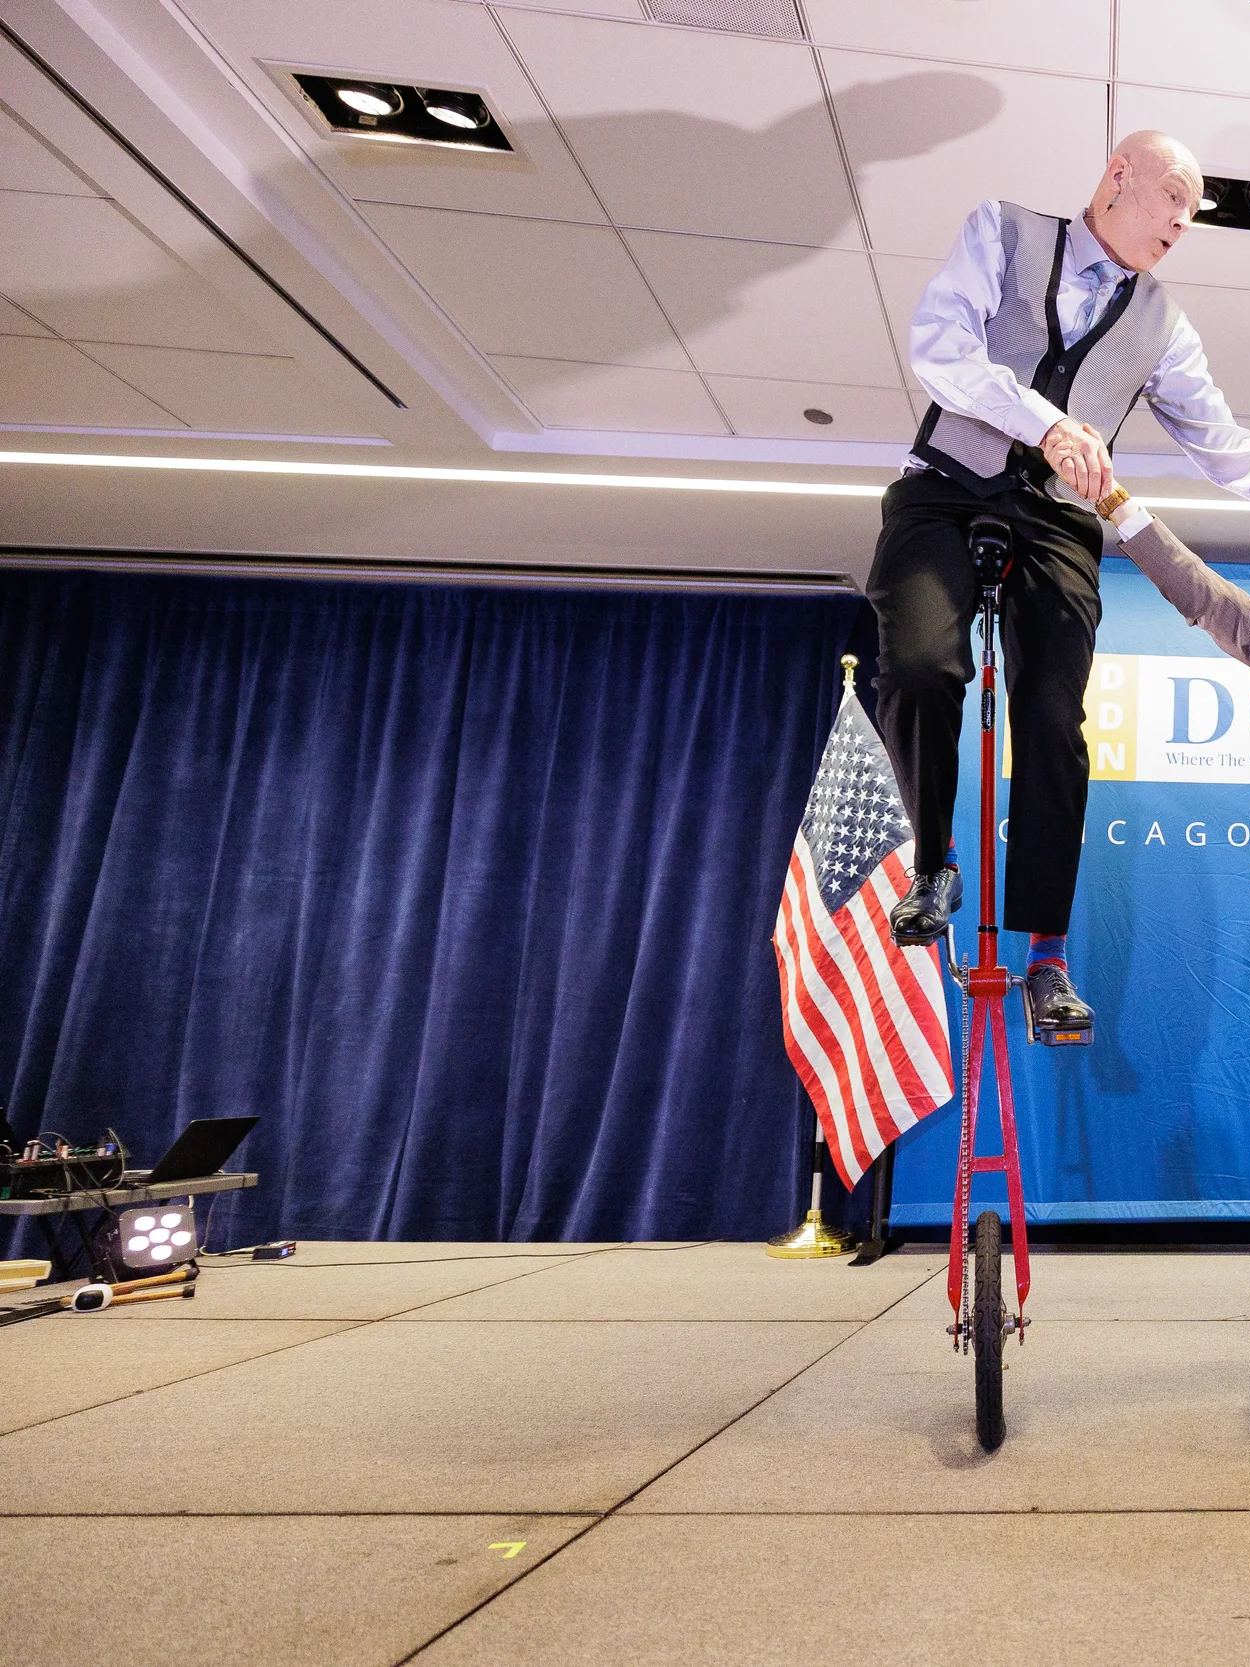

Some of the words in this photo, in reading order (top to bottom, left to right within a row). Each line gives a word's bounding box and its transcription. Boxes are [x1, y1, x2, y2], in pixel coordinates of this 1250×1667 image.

[1166, 752, 1213, 767] Where
[1218, 753, 1246, 767] The
[998, 818, 1250, 846] CICAGO
